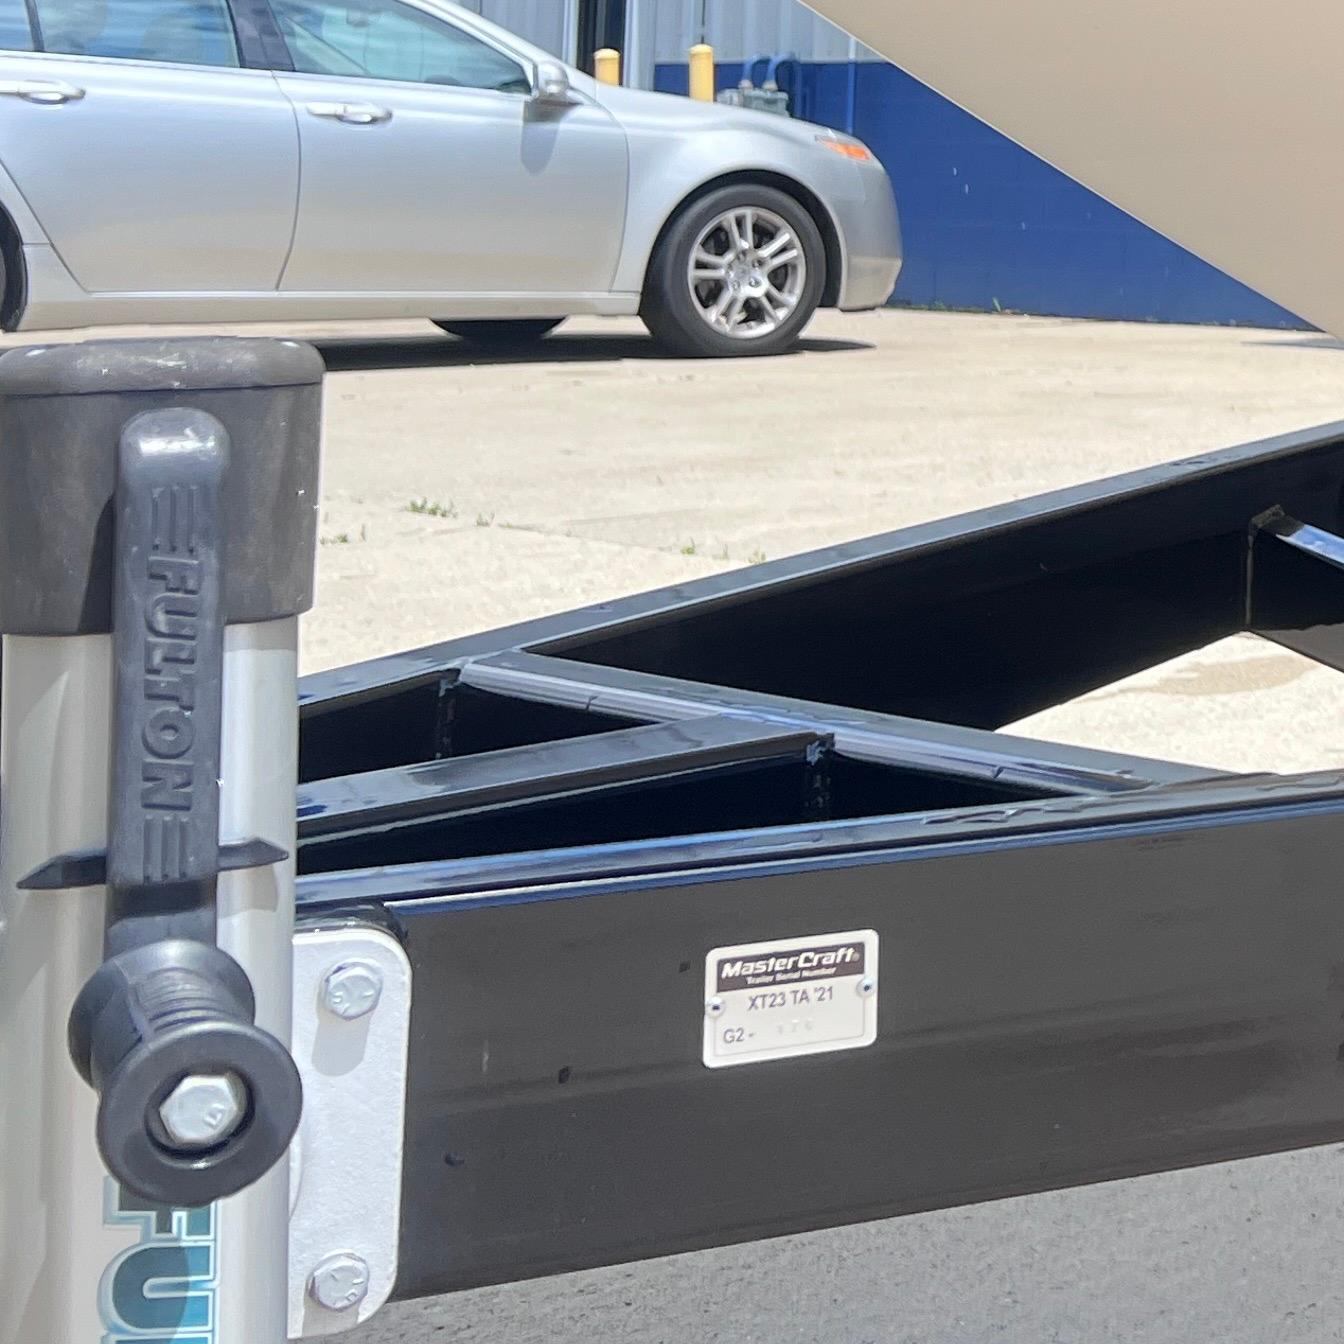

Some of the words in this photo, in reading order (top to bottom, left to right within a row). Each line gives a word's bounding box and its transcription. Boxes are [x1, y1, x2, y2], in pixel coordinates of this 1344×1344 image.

[142, 554, 200, 812] FULTON
[721, 947, 855, 979] MasterCraft
[746, 991, 786, 1012] XT23
[790, 988, 810, 1005] TA
[814, 985, 834, 1002] '21
[97, 1175, 220, 1344] FU
